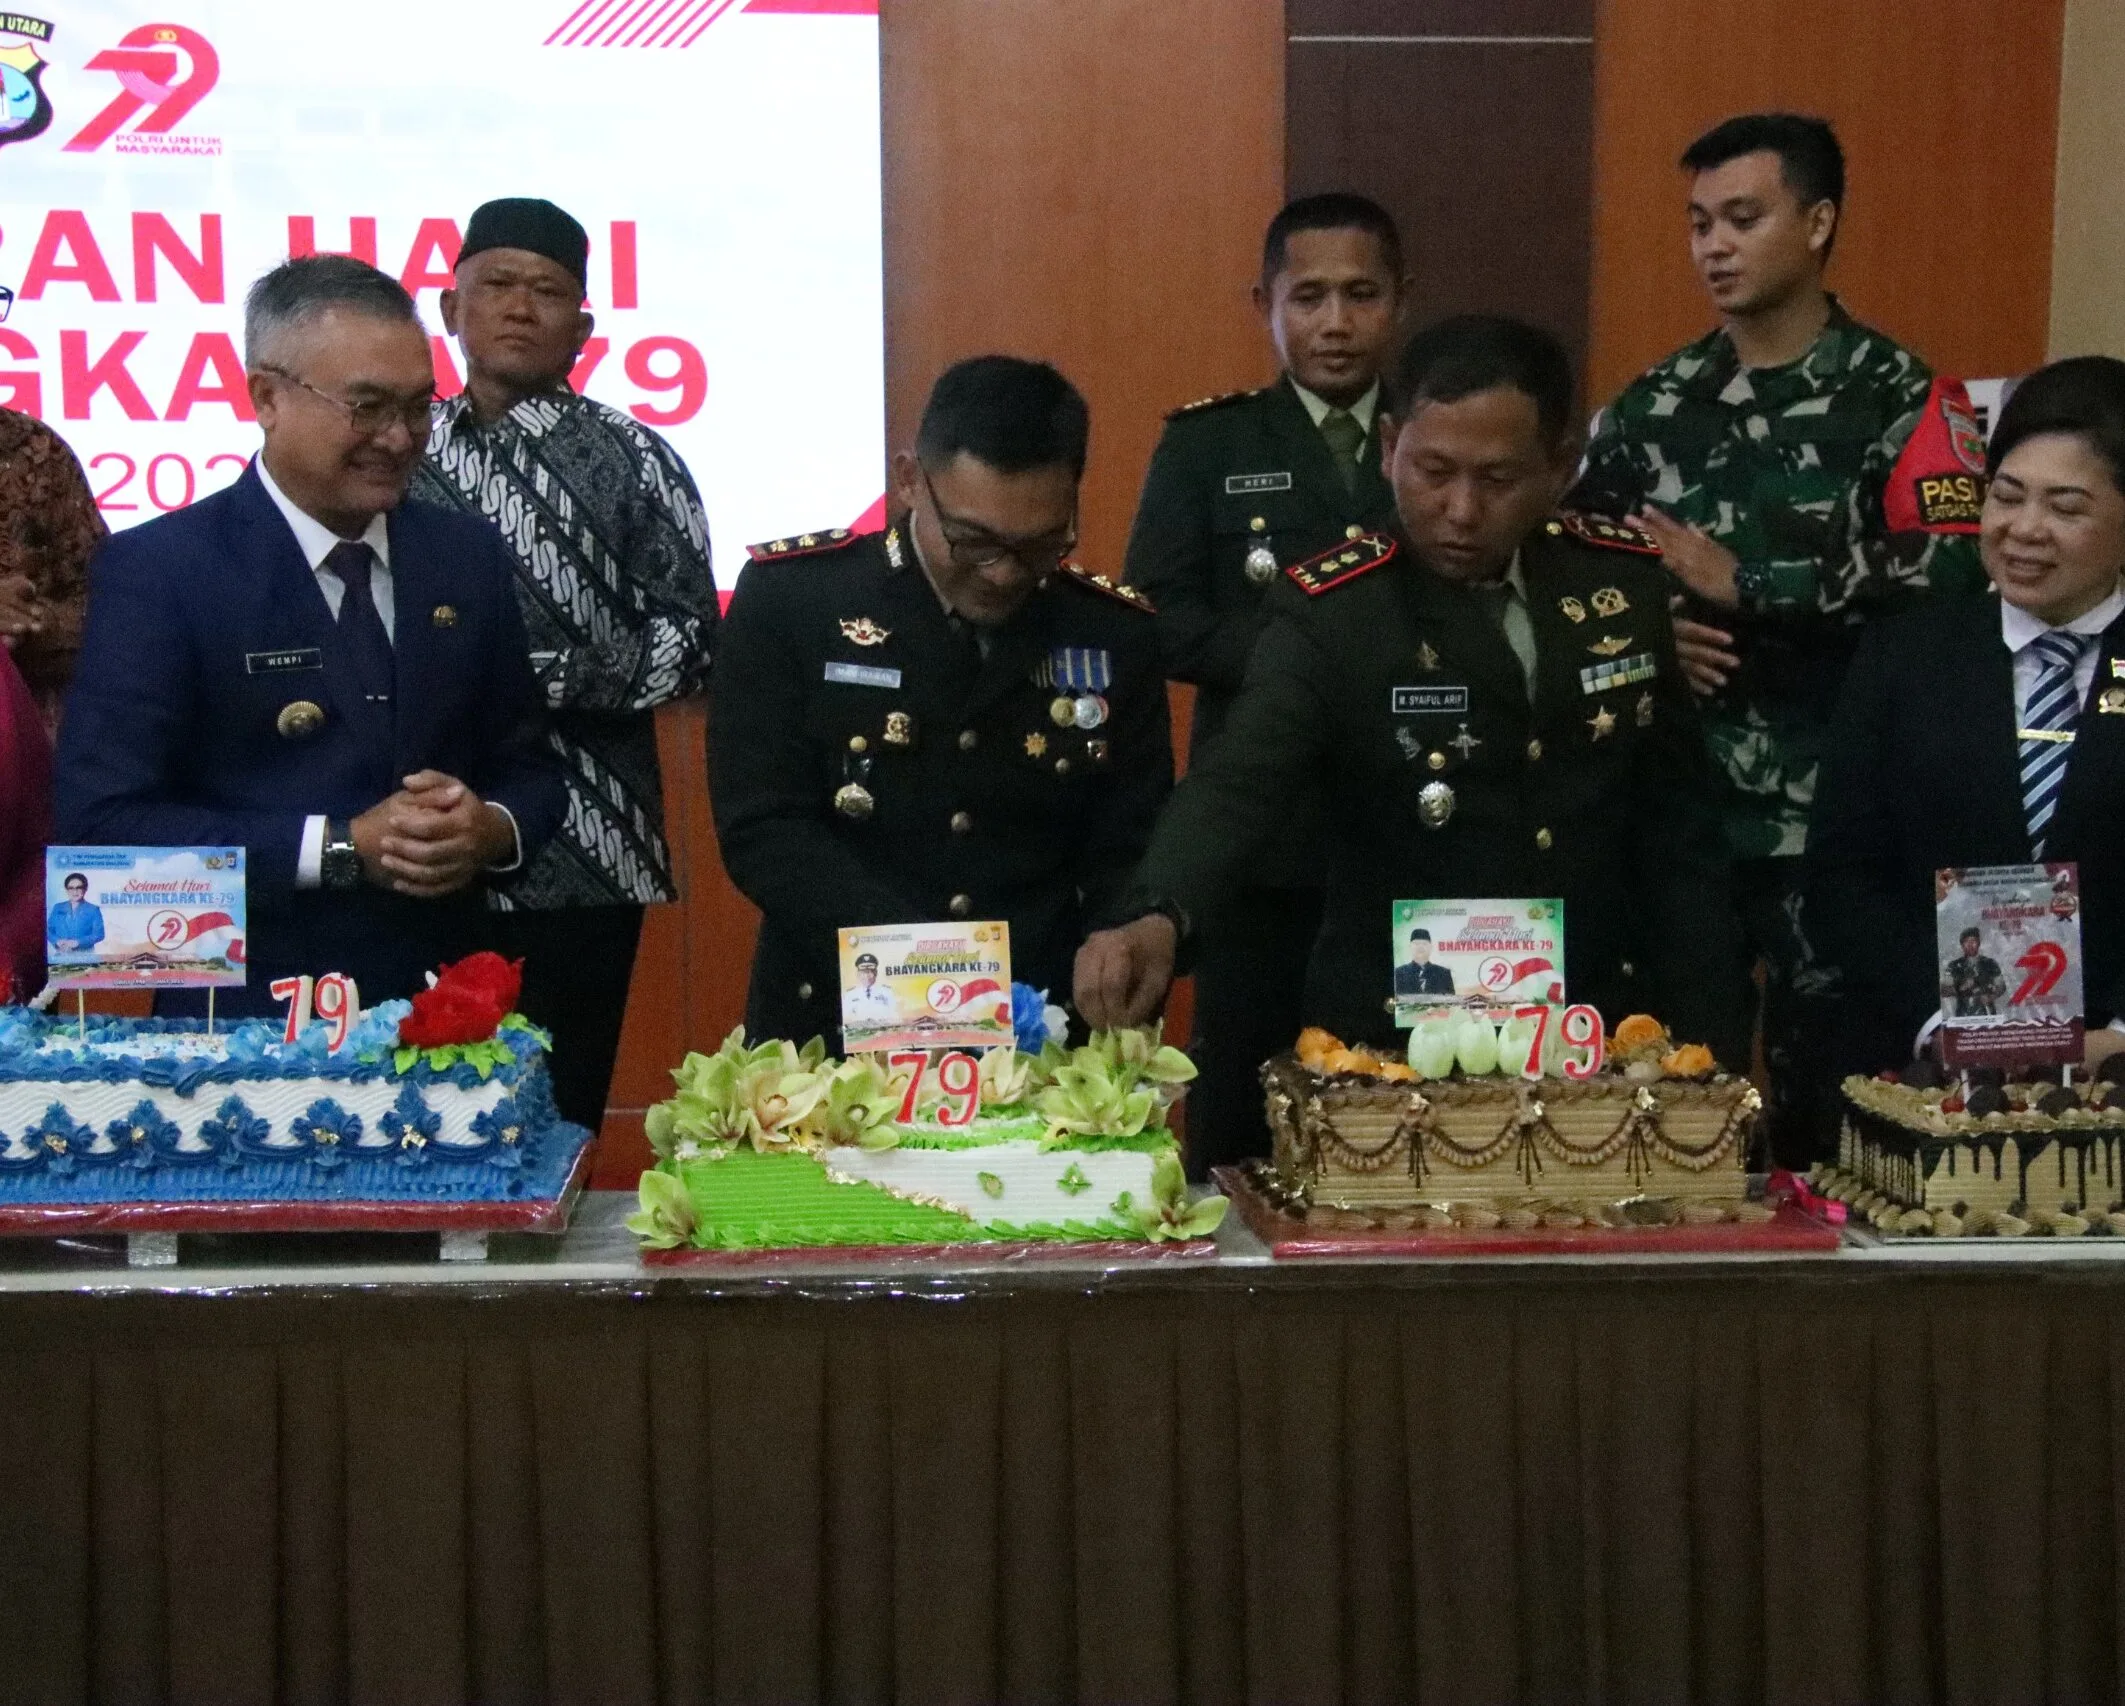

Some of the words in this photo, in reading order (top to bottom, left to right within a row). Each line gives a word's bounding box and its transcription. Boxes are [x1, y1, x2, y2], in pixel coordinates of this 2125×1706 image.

[7, 17, 46, 37] UTARA
[115, 134, 164, 143] POLRI
[169, 135, 221, 145] UNTUK
[115, 145, 222, 156] MASYARAKAT
[0, 210, 225, 304] AN
[288, 216, 638, 309] HAI
[1294, 566, 1321, 589] TNI
[1409, 695, 1441, 706] SYAIFUL
[1444, 695, 1462, 705] ARIF
[100, 892, 197, 905] BHAYANGKARA
[200, 892, 235, 904] KE-79
[1438, 940, 1519, 952] BHAYANGKARA
[885, 961, 967, 976] BHAYANGKARA
[969, 960, 1000, 973] KE-79
[270, 973, 357, 1056] 79
[1513, 1004, 1604, 1081] 79
[889, 1051, 980, 1128] 79
